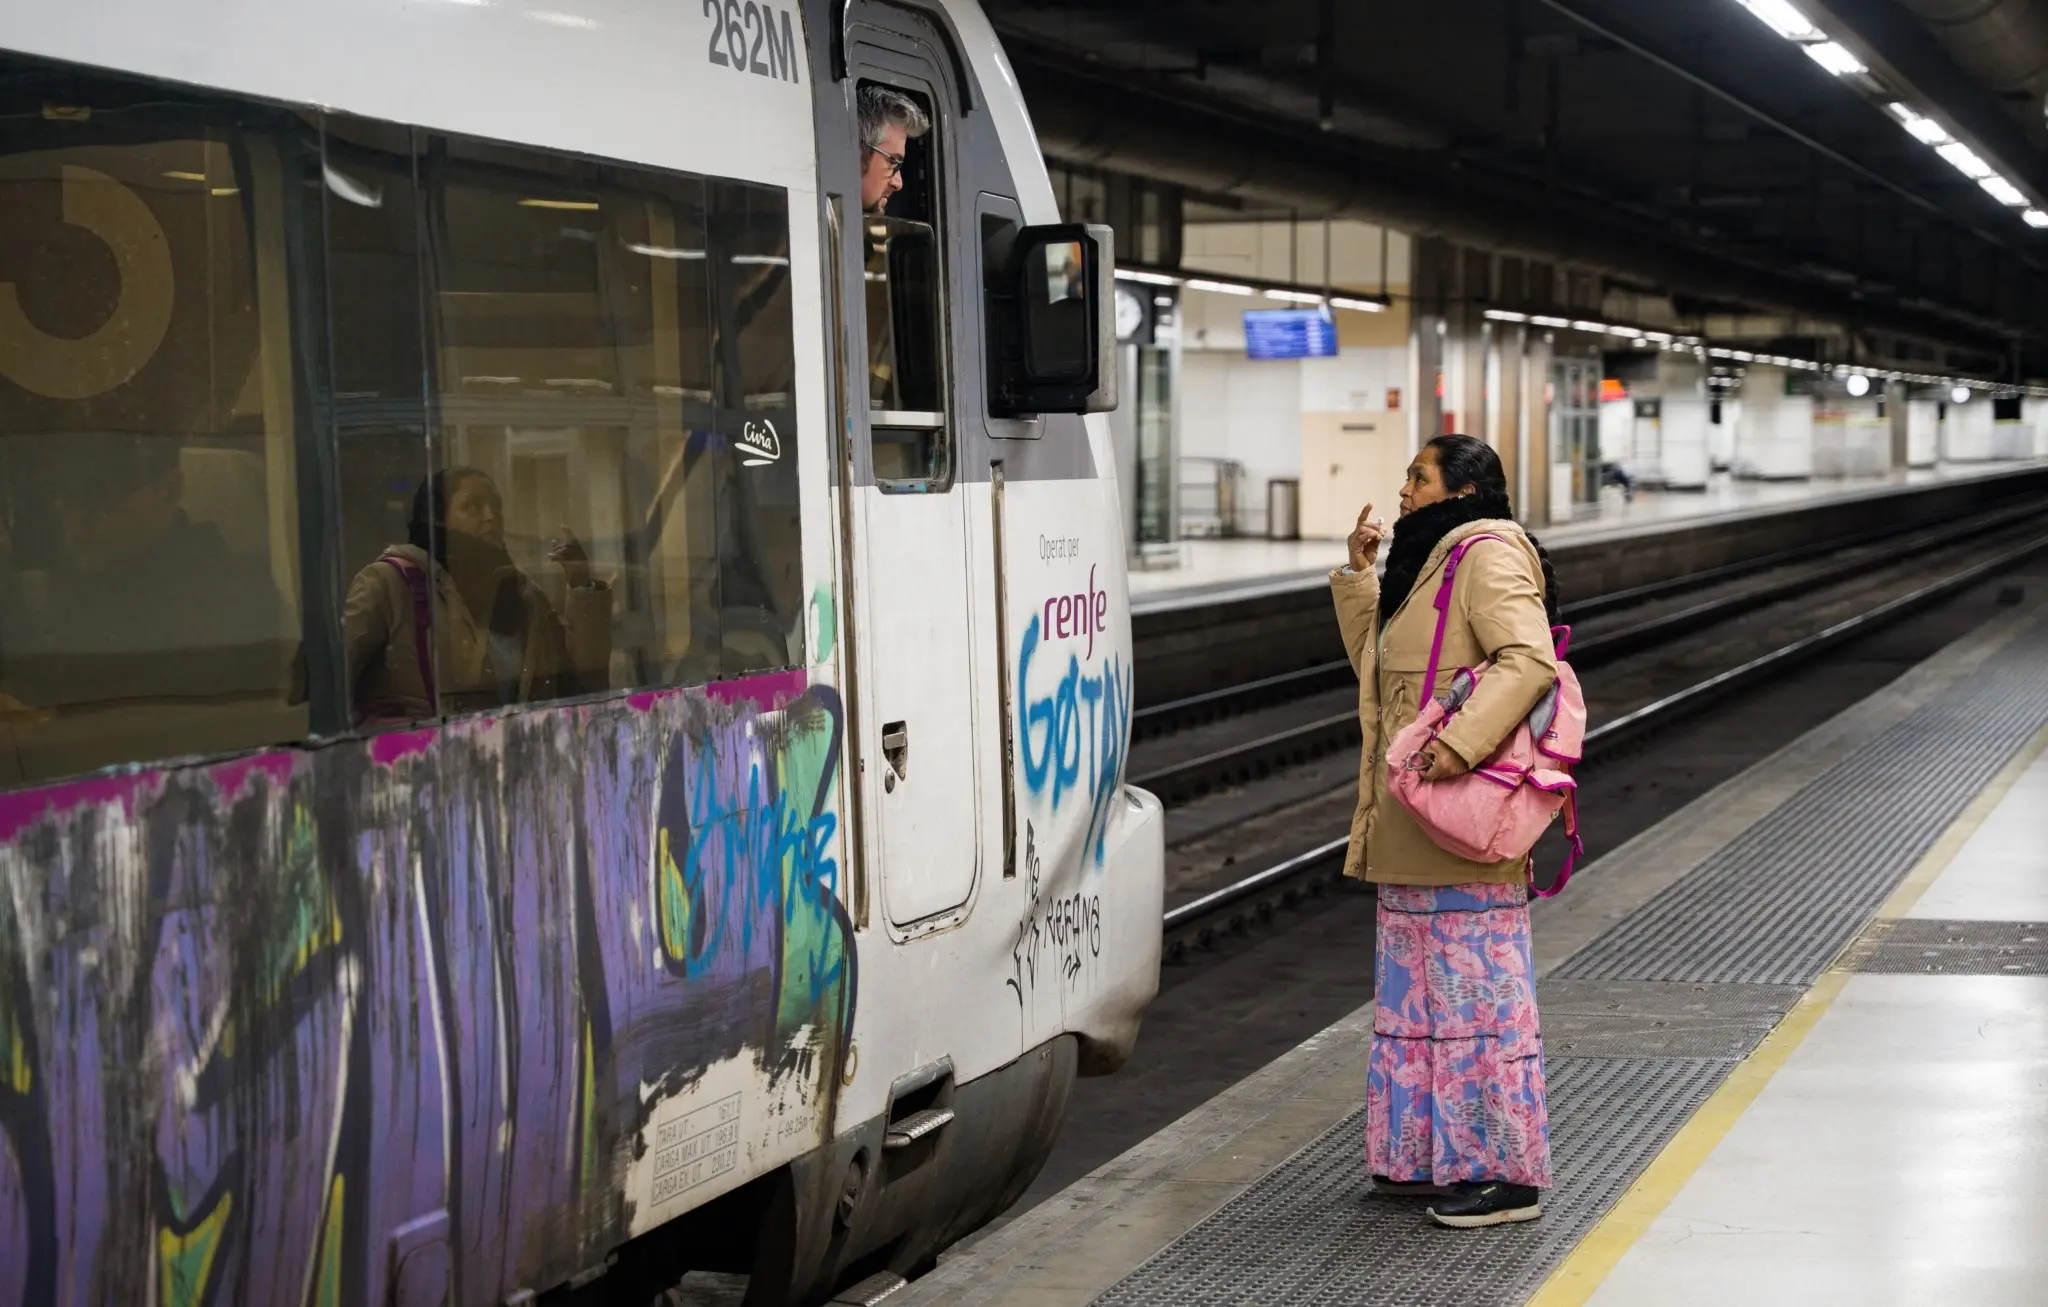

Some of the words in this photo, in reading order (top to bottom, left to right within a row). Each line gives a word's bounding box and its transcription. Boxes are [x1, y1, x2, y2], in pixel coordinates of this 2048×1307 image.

[703, 0, 799, 84] 262M
[744, 421, 772, 450] Civia
[1040, 533, 1066, 566] Operat
[1068, 537, 1079, 565] per
[1043, 562, 1107, 661] renfe
[656, 1147, 680, 1175] CARGA
[654, 1175, 678, 1201] CARGA
